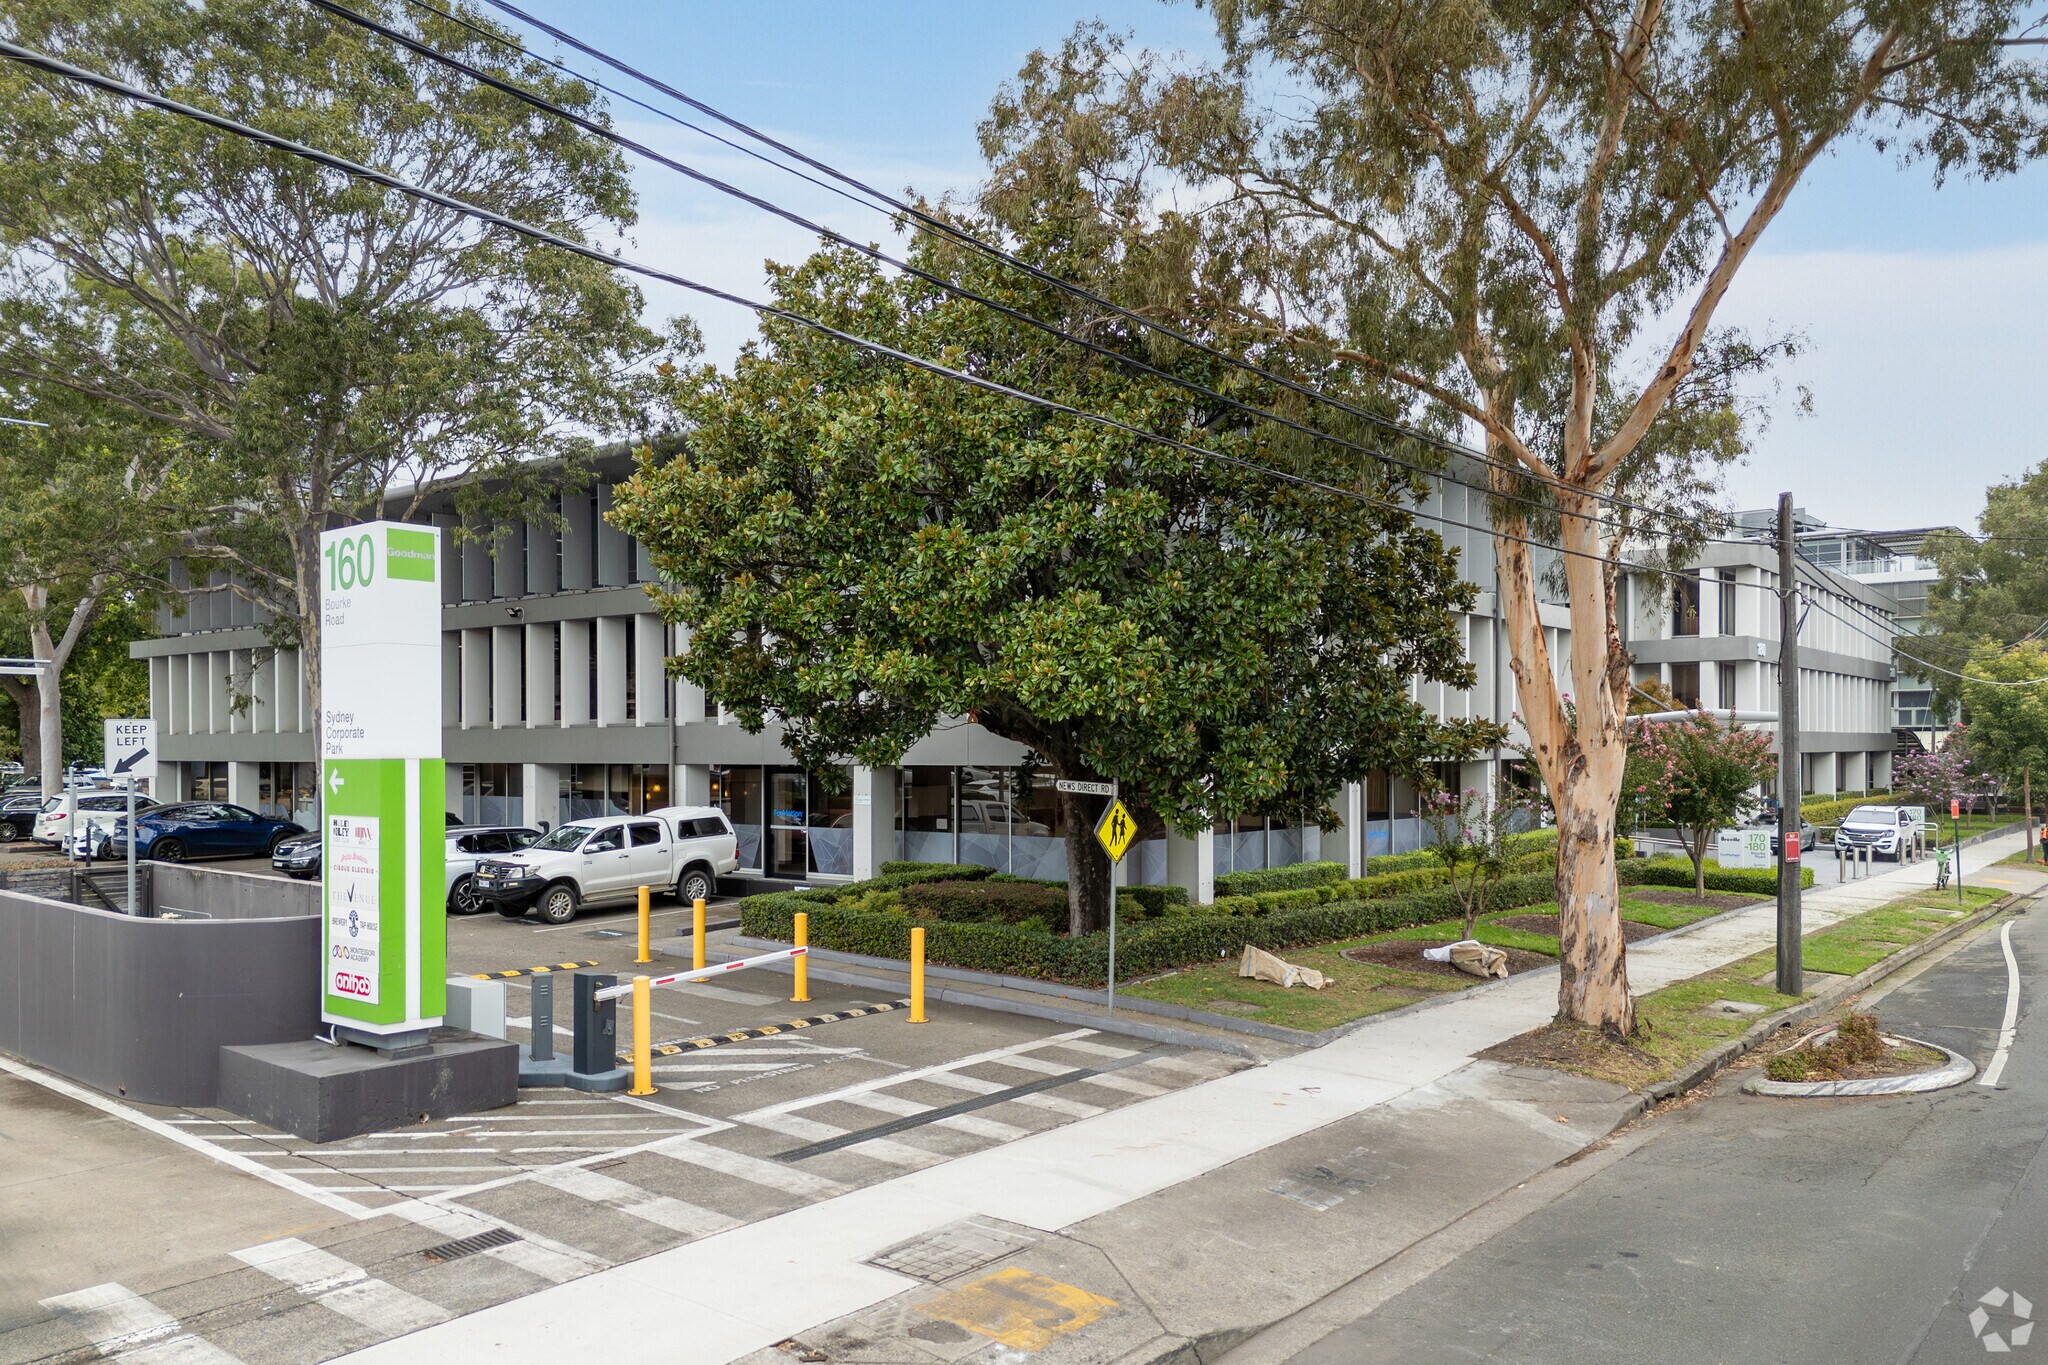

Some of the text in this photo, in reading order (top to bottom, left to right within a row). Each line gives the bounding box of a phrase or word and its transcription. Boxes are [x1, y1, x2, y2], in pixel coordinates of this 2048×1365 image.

[387, 547, 436, 560] Goodman
[325, 534, 375, 591] 160
[325, 597, 351, 611] Bourke
[325, 613, 345, 626] Road
[326, 710, 354, 726] Sydney
[116, 725, 147, 734] KEEP
[326, 726, 365, 741] Corporate
[116, 737, 146, 746] LEFT
[326, 742, 343, 755] Park
[1058, 782, 1110, 794] NEWS DIRECT RD
[1749, 834, 1766, 842] 170
[332, 881, 376, 905] THE VENUE
[350, 946, 376, 957] MONTESSORI
[350, 954, 369, 963] ACADEMY
